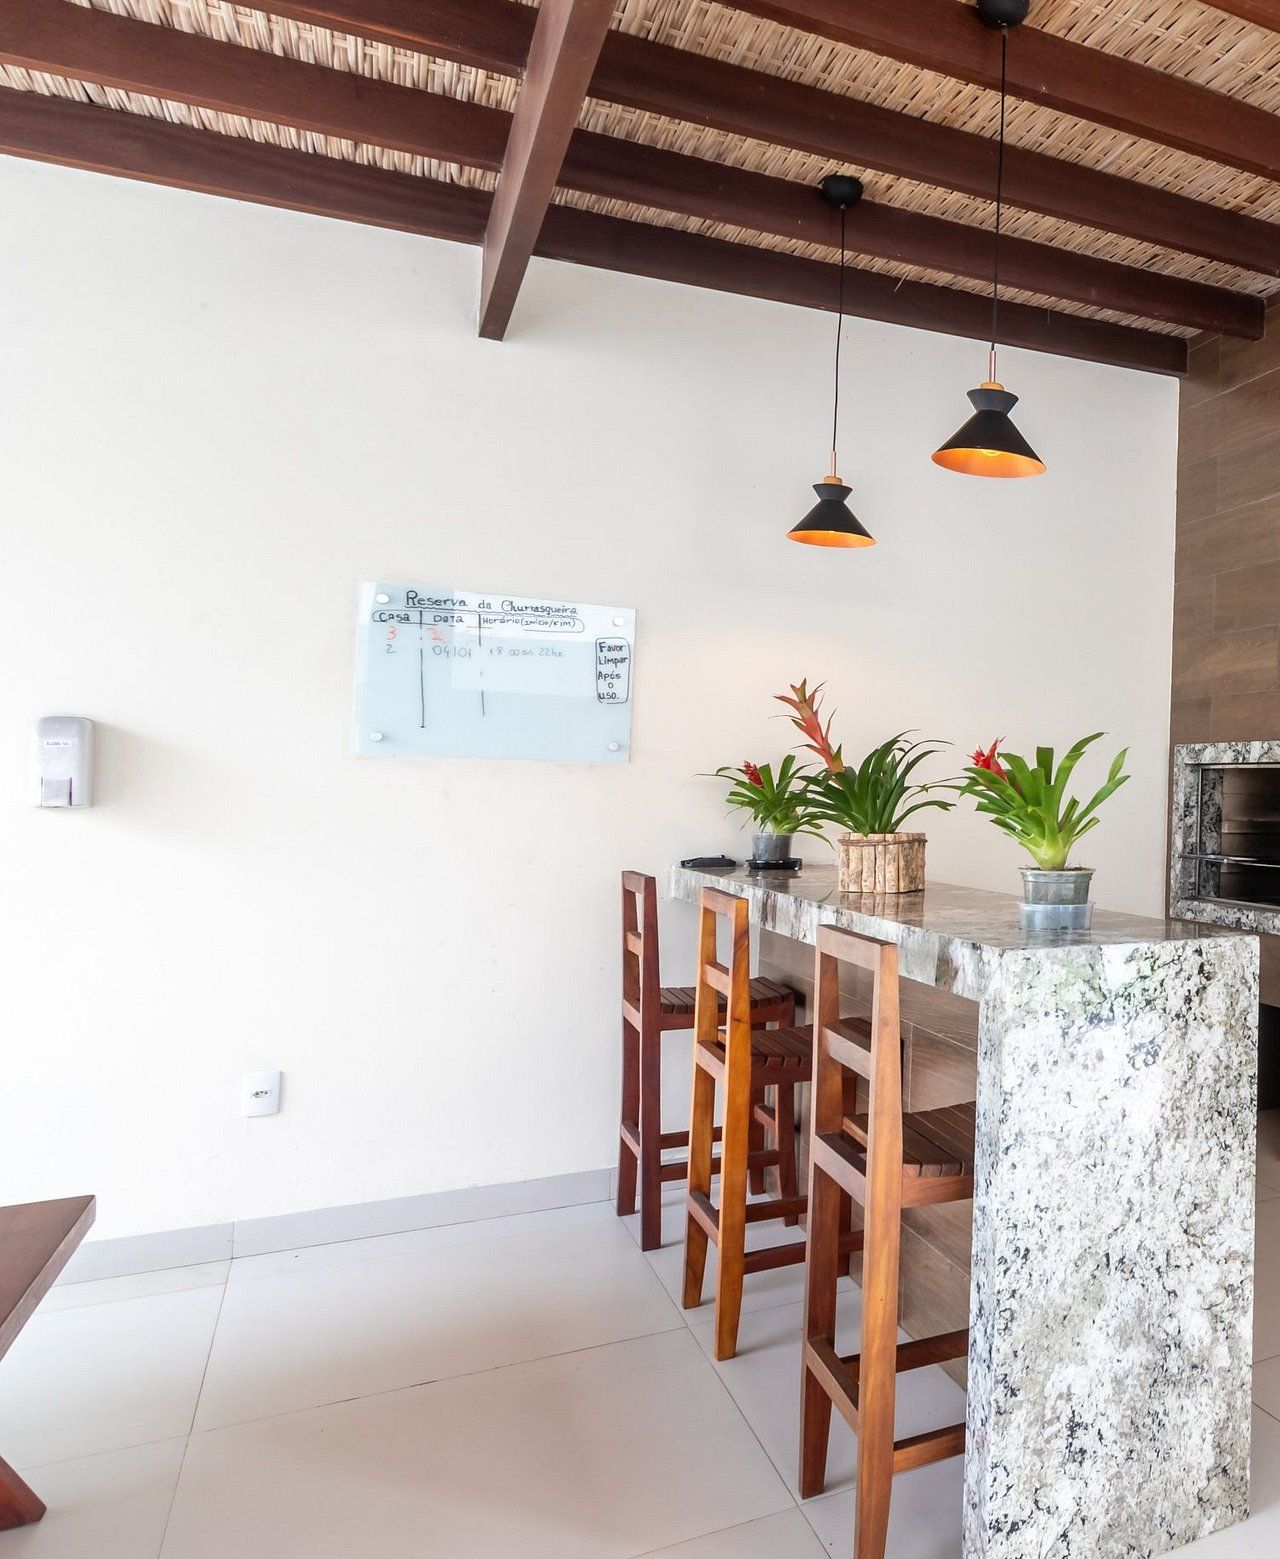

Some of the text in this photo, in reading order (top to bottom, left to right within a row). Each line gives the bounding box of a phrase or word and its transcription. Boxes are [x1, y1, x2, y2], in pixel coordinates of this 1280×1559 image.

[405, 590, 578, 617] Reserva da Churrasqueira
[378, 611, 411, 623] Casa
[386, 643, 397, 654] 2
[598, 641, 626, 653] Favor
[597, 655, 628, 668] Limpar
